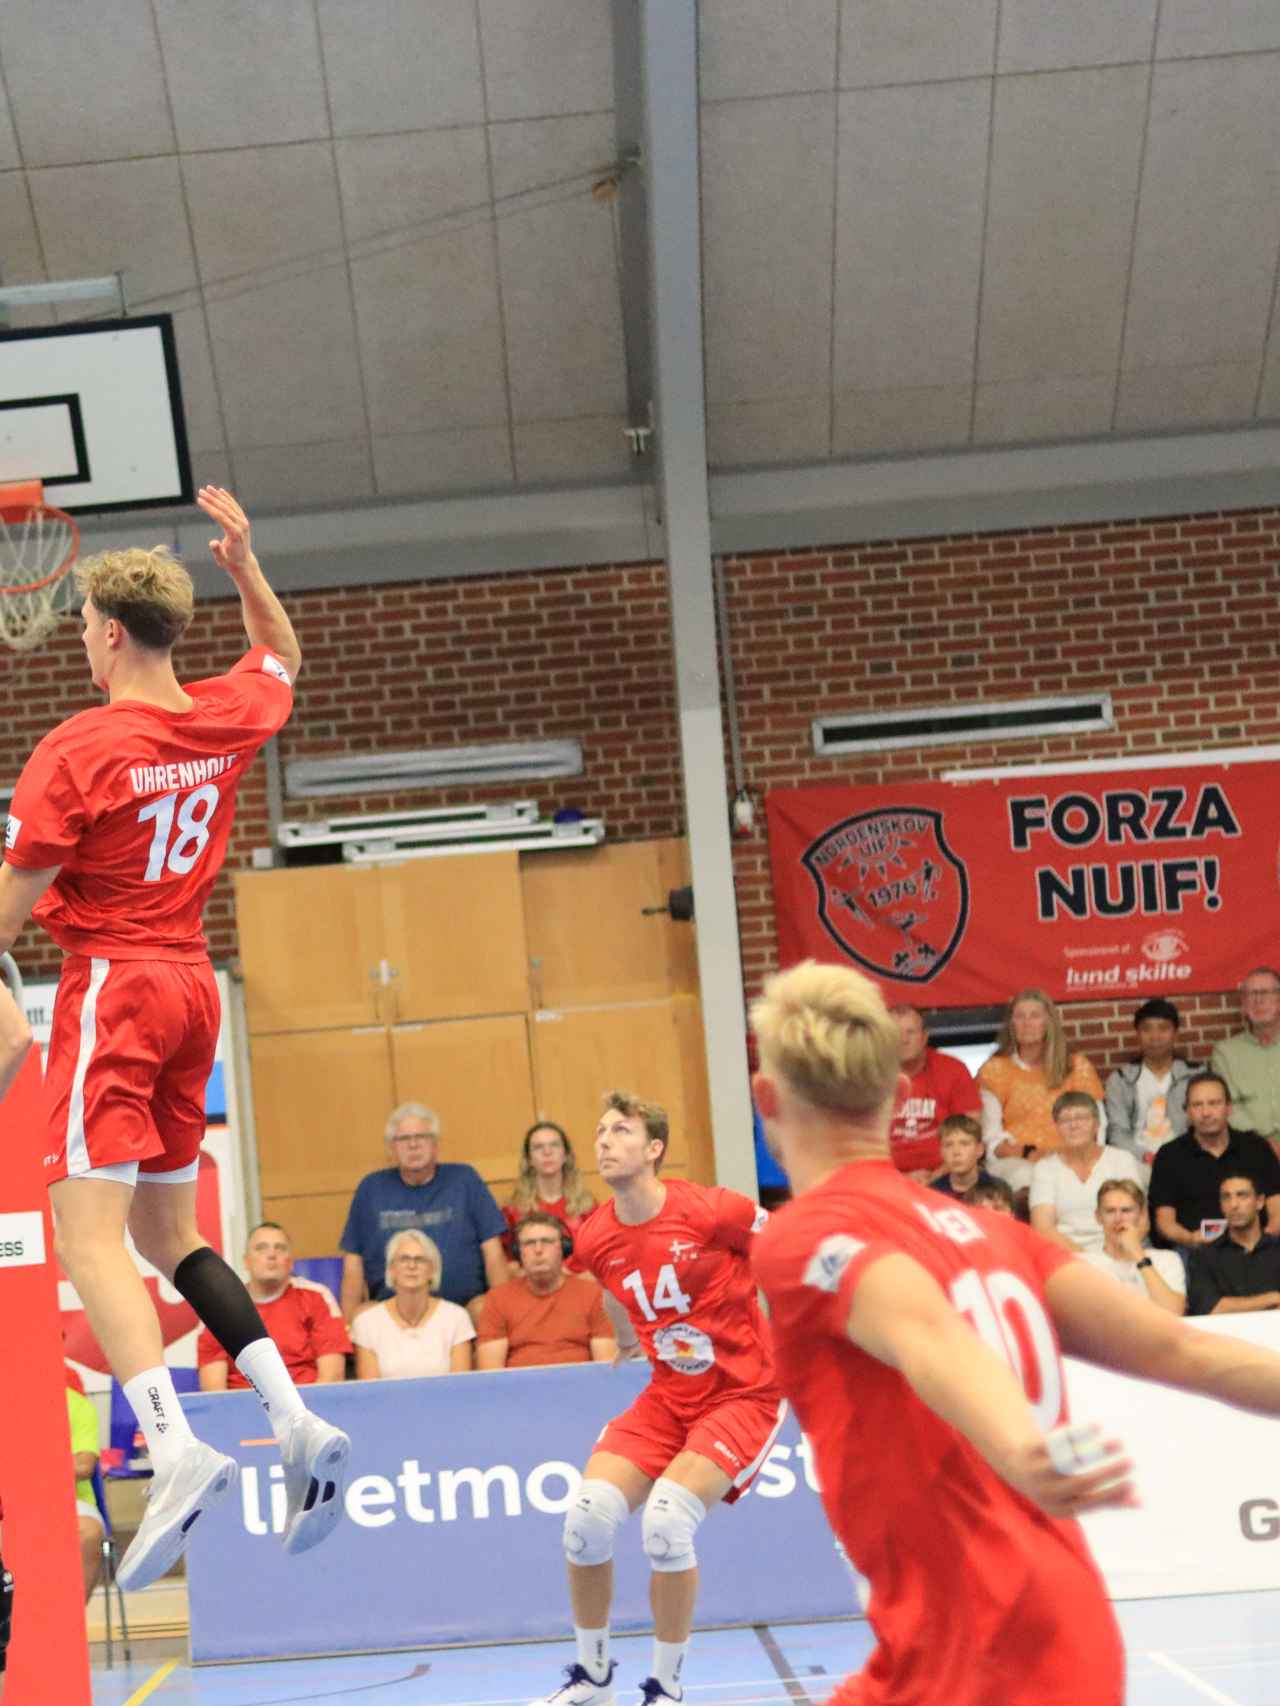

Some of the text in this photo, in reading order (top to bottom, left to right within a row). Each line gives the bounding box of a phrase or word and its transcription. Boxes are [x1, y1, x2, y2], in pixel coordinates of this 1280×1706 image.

[137, 783, 220, 882] 18
[1008, 784, 1240, 850] FORZA
[813, 817, 929, 865] NORDENSKOV
[860, 837, 889, 857] UIF
[868, 880, 918, 907] 1976
[1036, 858, 1222, 920] NUIF!
[1066, 963, 1192, 985] lund skilte
[622, 1263, 691, 1322] 14
[147, 1386, 166, 1419] CRAFT
[1239, 1497, 1280, 1542] G
